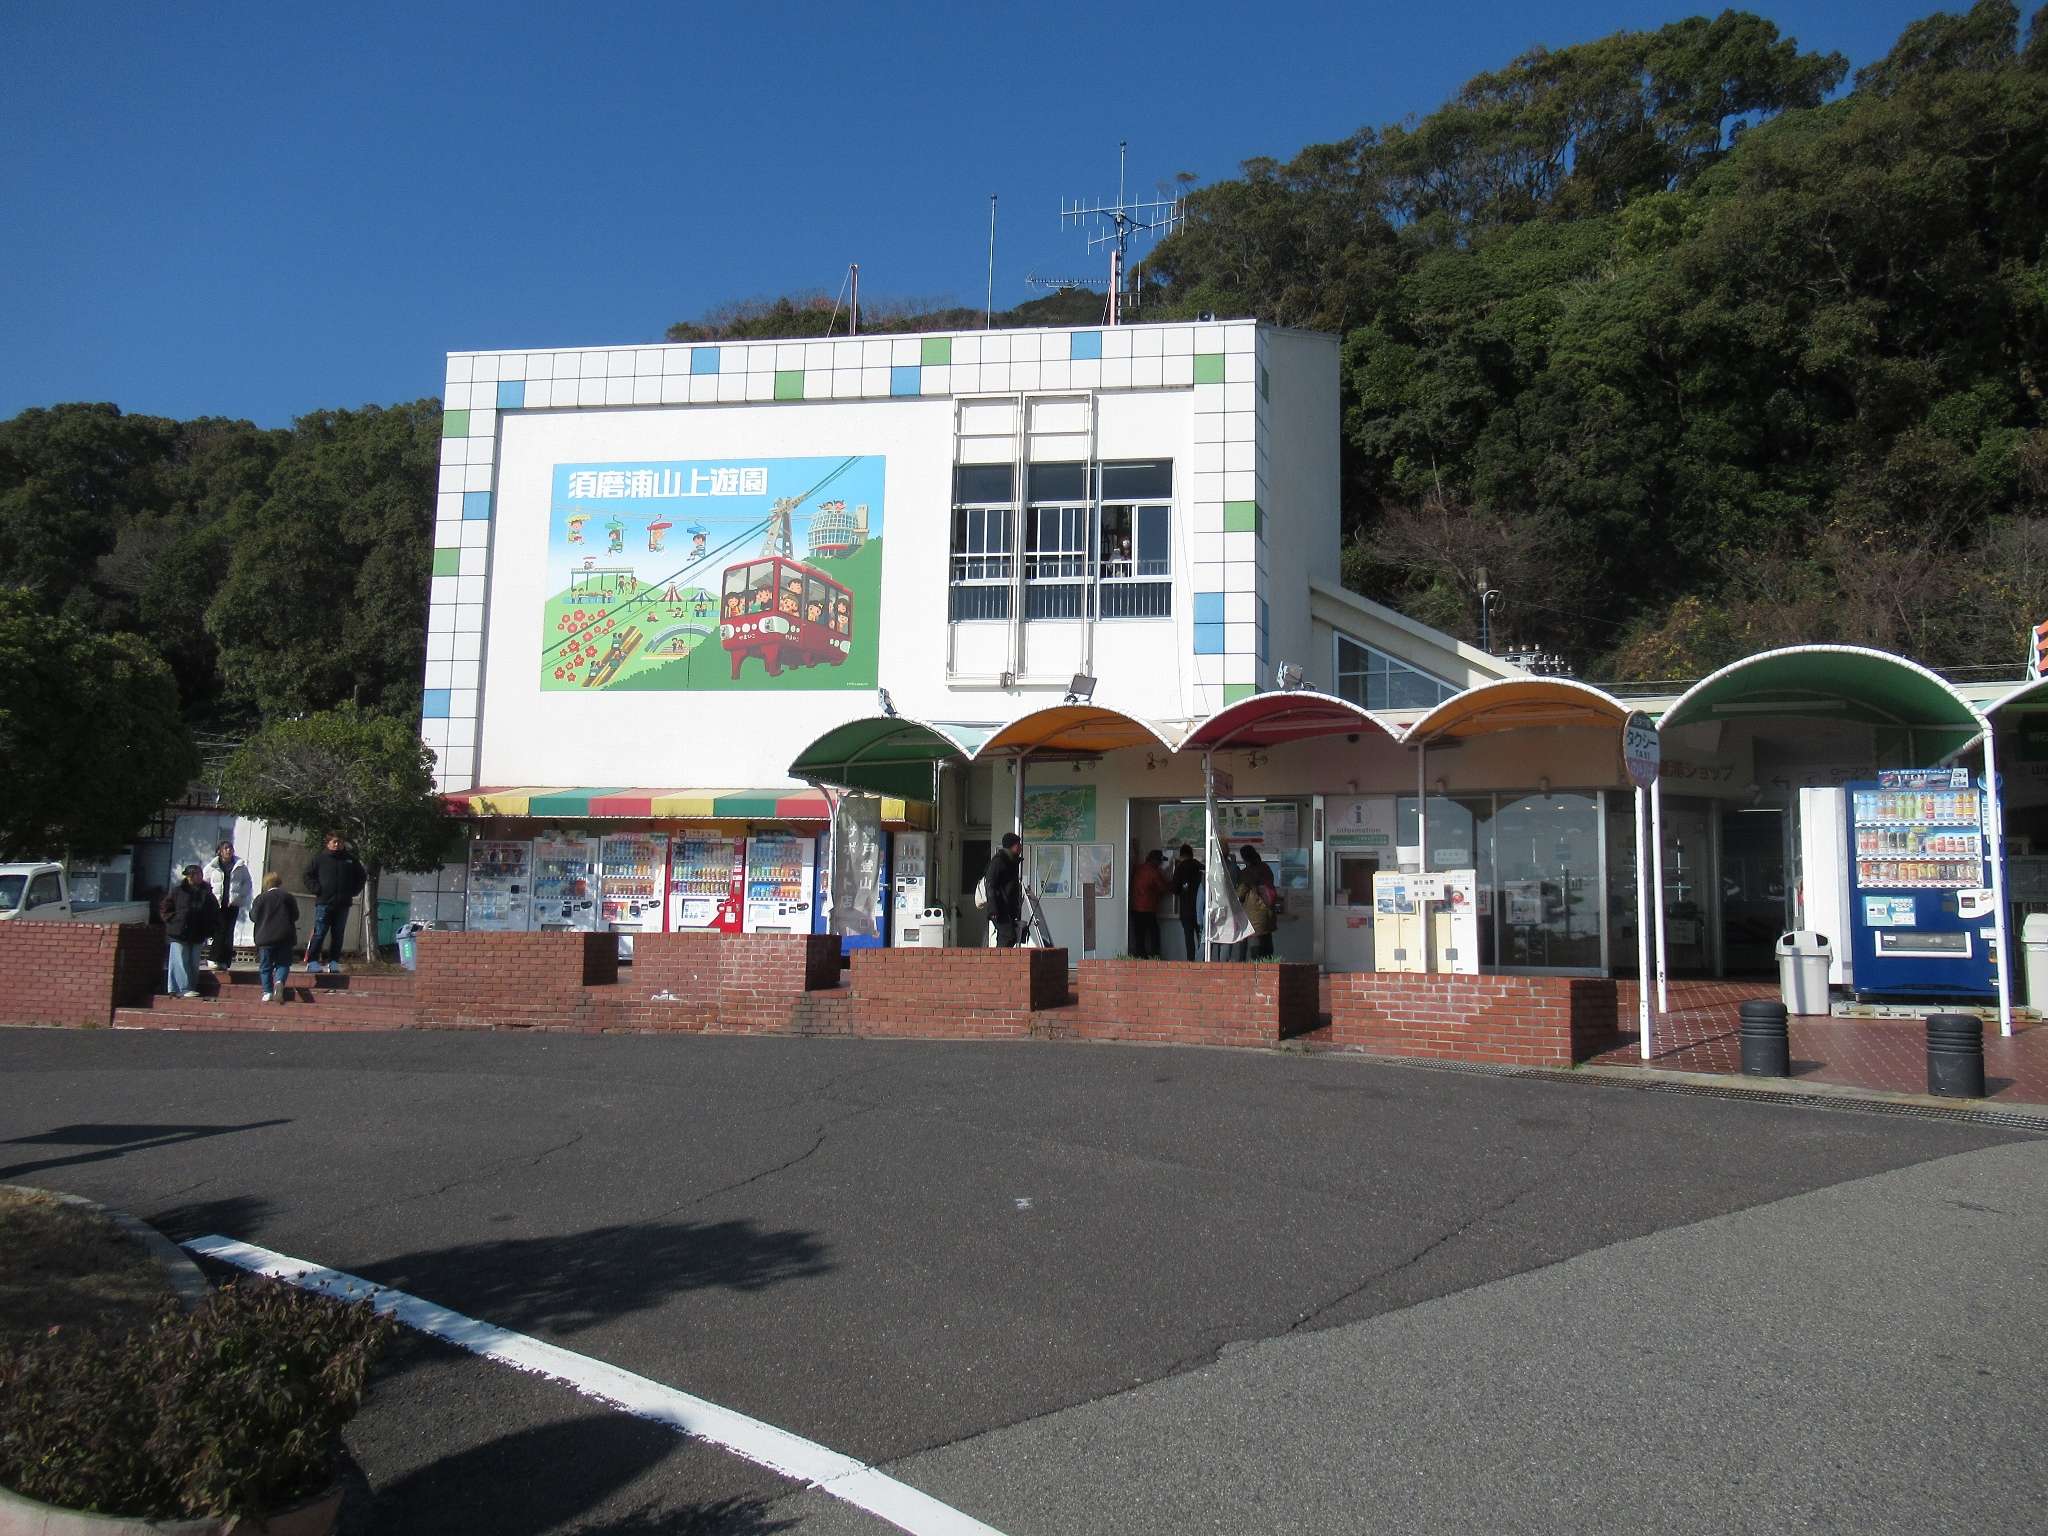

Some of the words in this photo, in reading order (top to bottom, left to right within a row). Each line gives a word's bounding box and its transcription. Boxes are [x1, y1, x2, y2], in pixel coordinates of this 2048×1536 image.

[568, 467, 768, 499] 須磨浦山上遊園
[1626, 729, 1657, 749] タクシー
